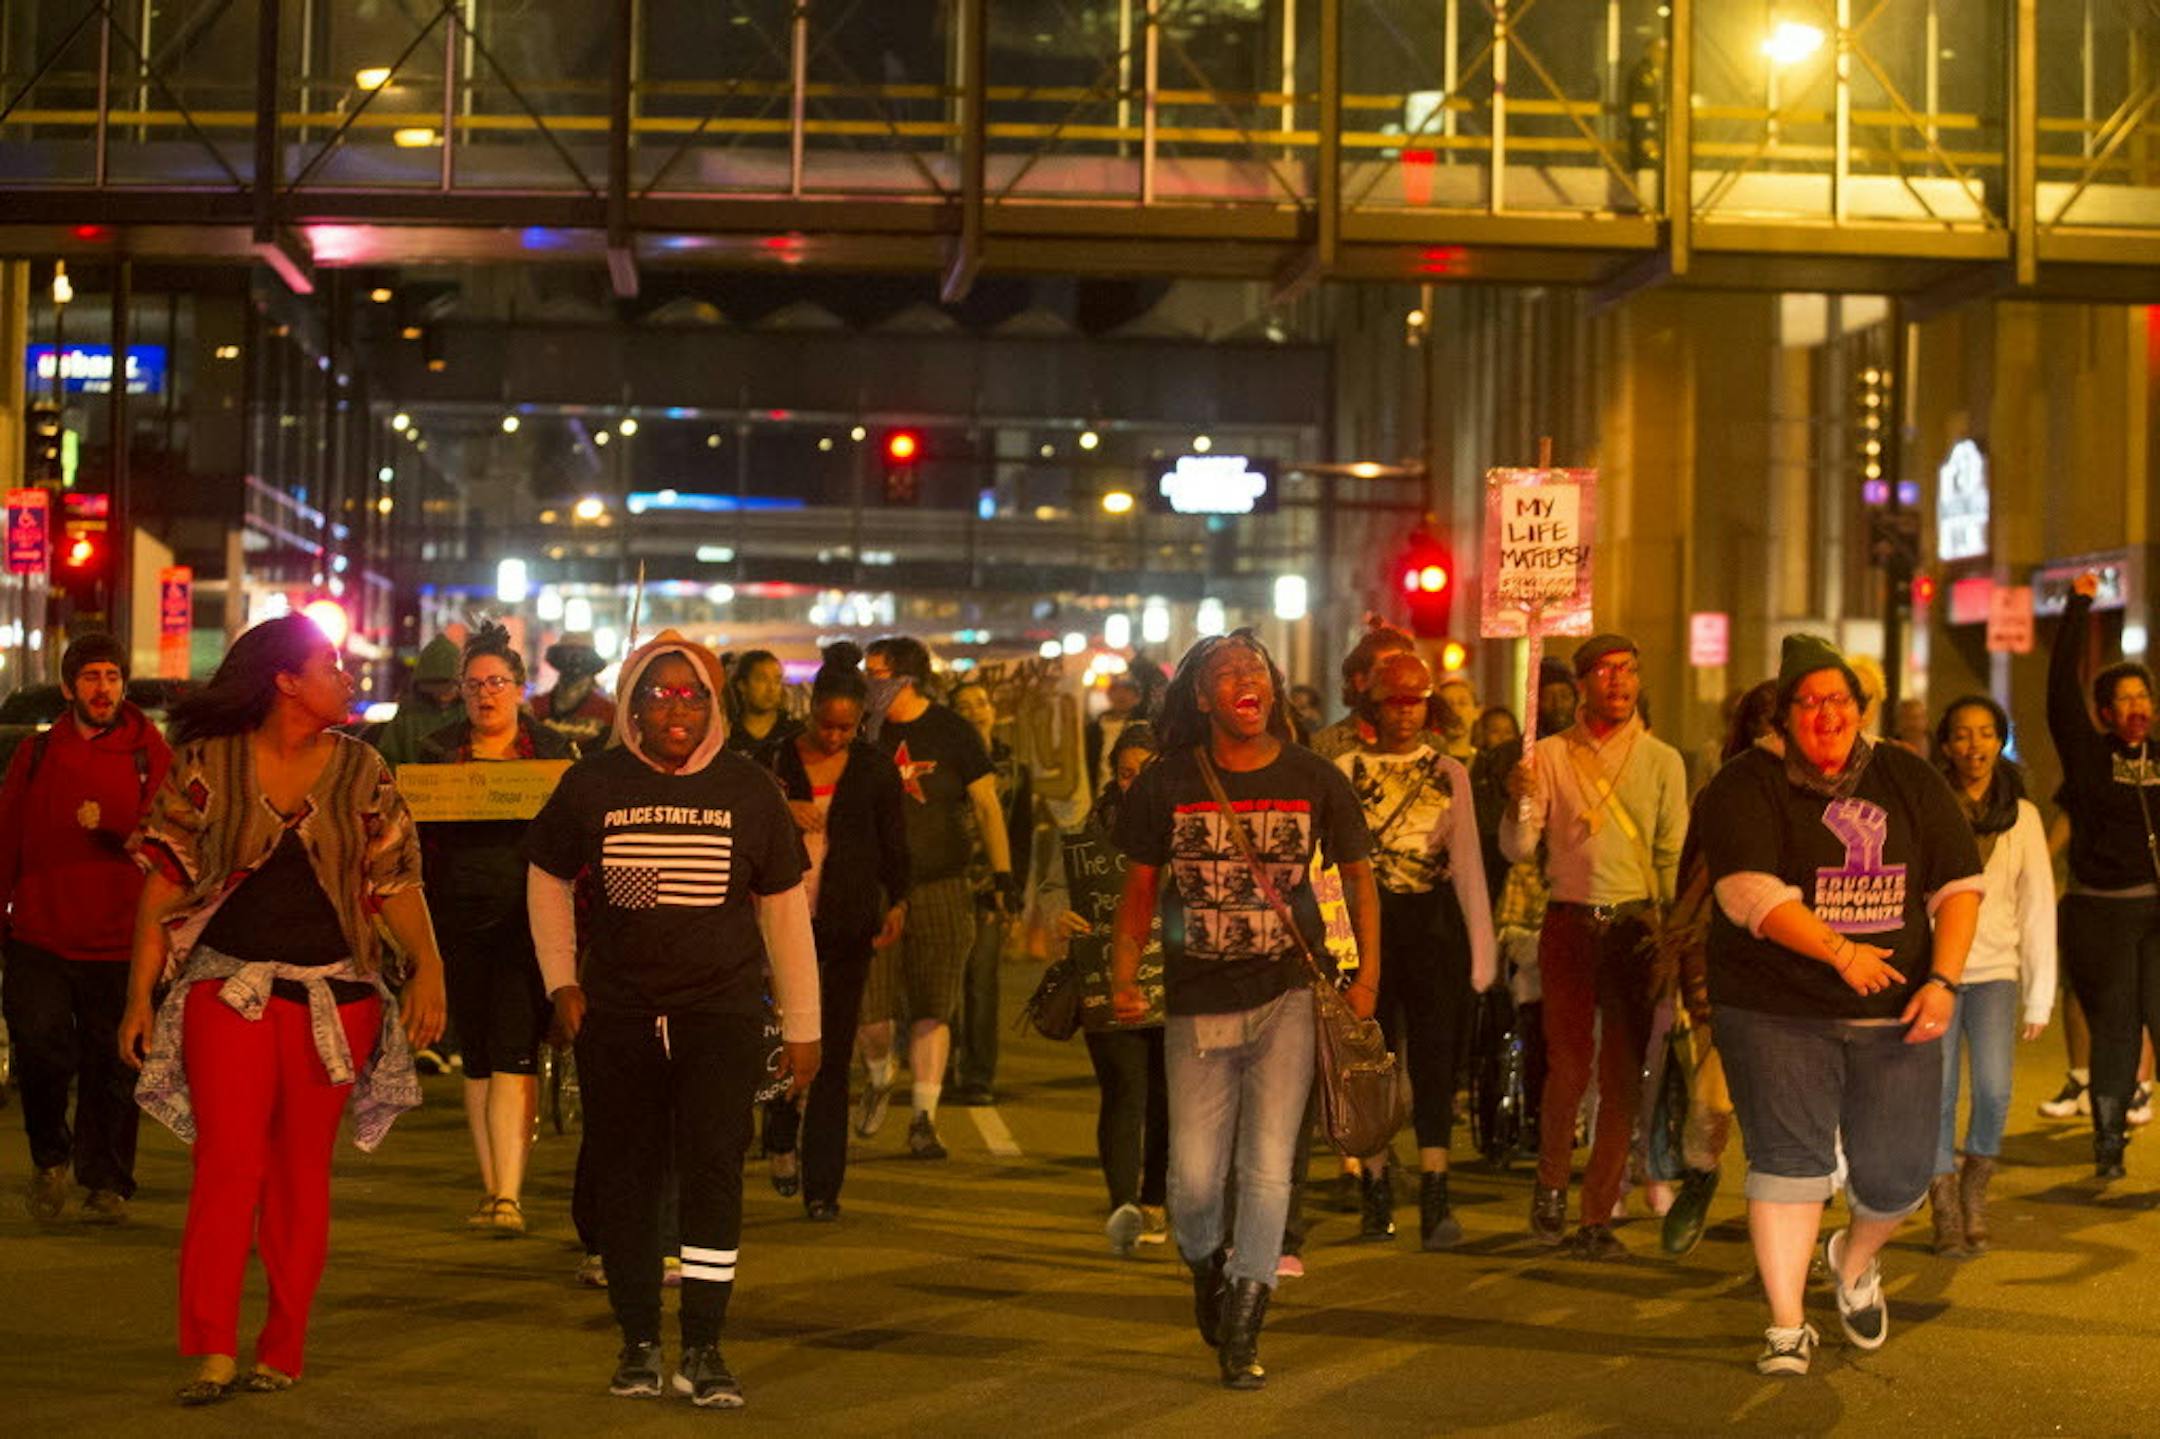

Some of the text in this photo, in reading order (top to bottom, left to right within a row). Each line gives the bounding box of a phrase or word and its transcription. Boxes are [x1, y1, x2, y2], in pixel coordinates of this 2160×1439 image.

[1516, 497, 1555, 518] MY
[1508, 521, 1569, 543] LIFE
[1500, 546, 1591, 569] MATTERS!
[604, 806, 652, 829] POLICE
[703, 809, 732, 829] USA
[1066, 841, 1111, 878] The
[1816, 875, 1906, 890] EDUCATE
[1815, 889, 1906, 905] EMPOWER
[1814, 903, 1905, 923] ORGANIZE
